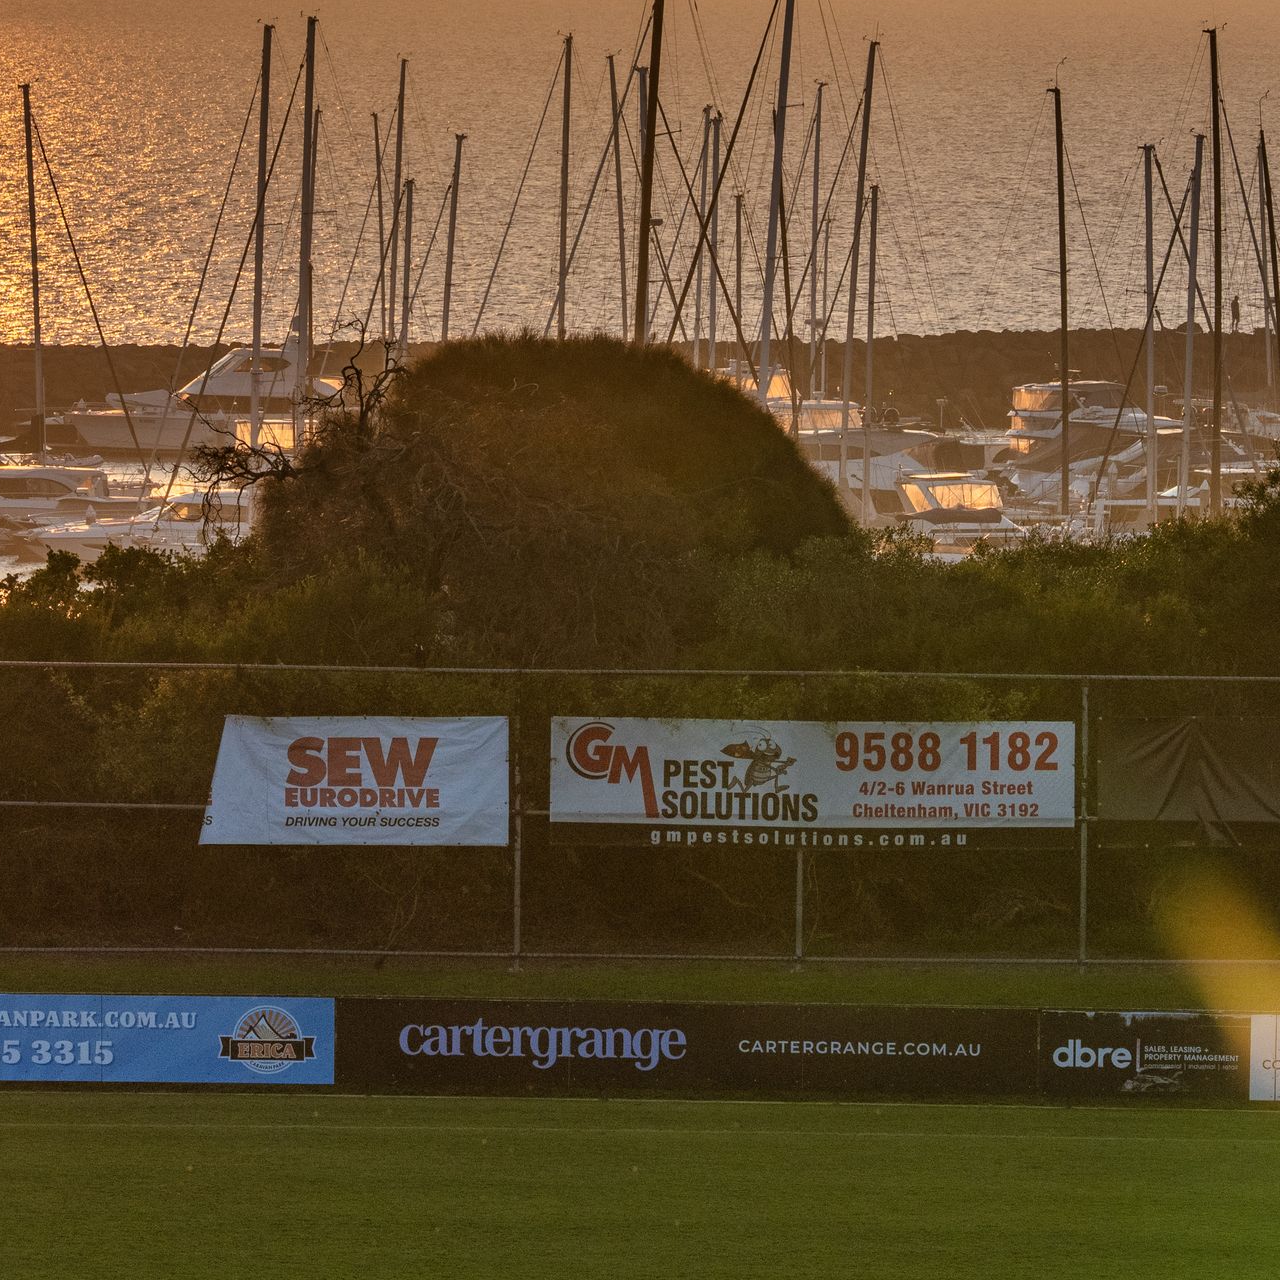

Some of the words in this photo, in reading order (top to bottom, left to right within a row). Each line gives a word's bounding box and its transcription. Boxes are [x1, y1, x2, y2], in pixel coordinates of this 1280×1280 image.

[285, 736, 439, 787] SEW
[834, 731, 943, 772] 9588
[959, 732, 1059, 772] 1182
[566, 722, 660, 819] GM
[663, 759, 734, 789] PEST
[284, 787, 440, 808] EURODRIVE
[859, 781, 905, 796] 4/2-6
[911, 781, 975, 796] Wanrua
[981, 780, 1033, 796] Street
[661, 790, 818, 822] SOLUTIONS
[852, 803, 959, 820] Cheltenham,
[963, 803, 991, 818] VIC
[997, 803, 1039, 818] 3192
[284, 816, 336, 828] DRIVING
[341, 816, 376, 828] YOUR
[379, 816, 440, 828] SUCCESS
[650, 827, 968, 848] gmpestsolutions.com.au
[31, 1041, 114, 1065] 3315
[237, 1042, 297, 1059] ERICA
[399, 1018, 687, 1071] cartergrange
[738, 1039, 982, 1057] CARTERGRANGE.COM.AU
[1052, 1039, 1133, 1069] dbre
[1170, 1046, 1202, 1054] LEASING
[1144, 1053, 1181, 1061] PROPERTY
[1183, 1054, 1240, 1062] MANAGEMENT
